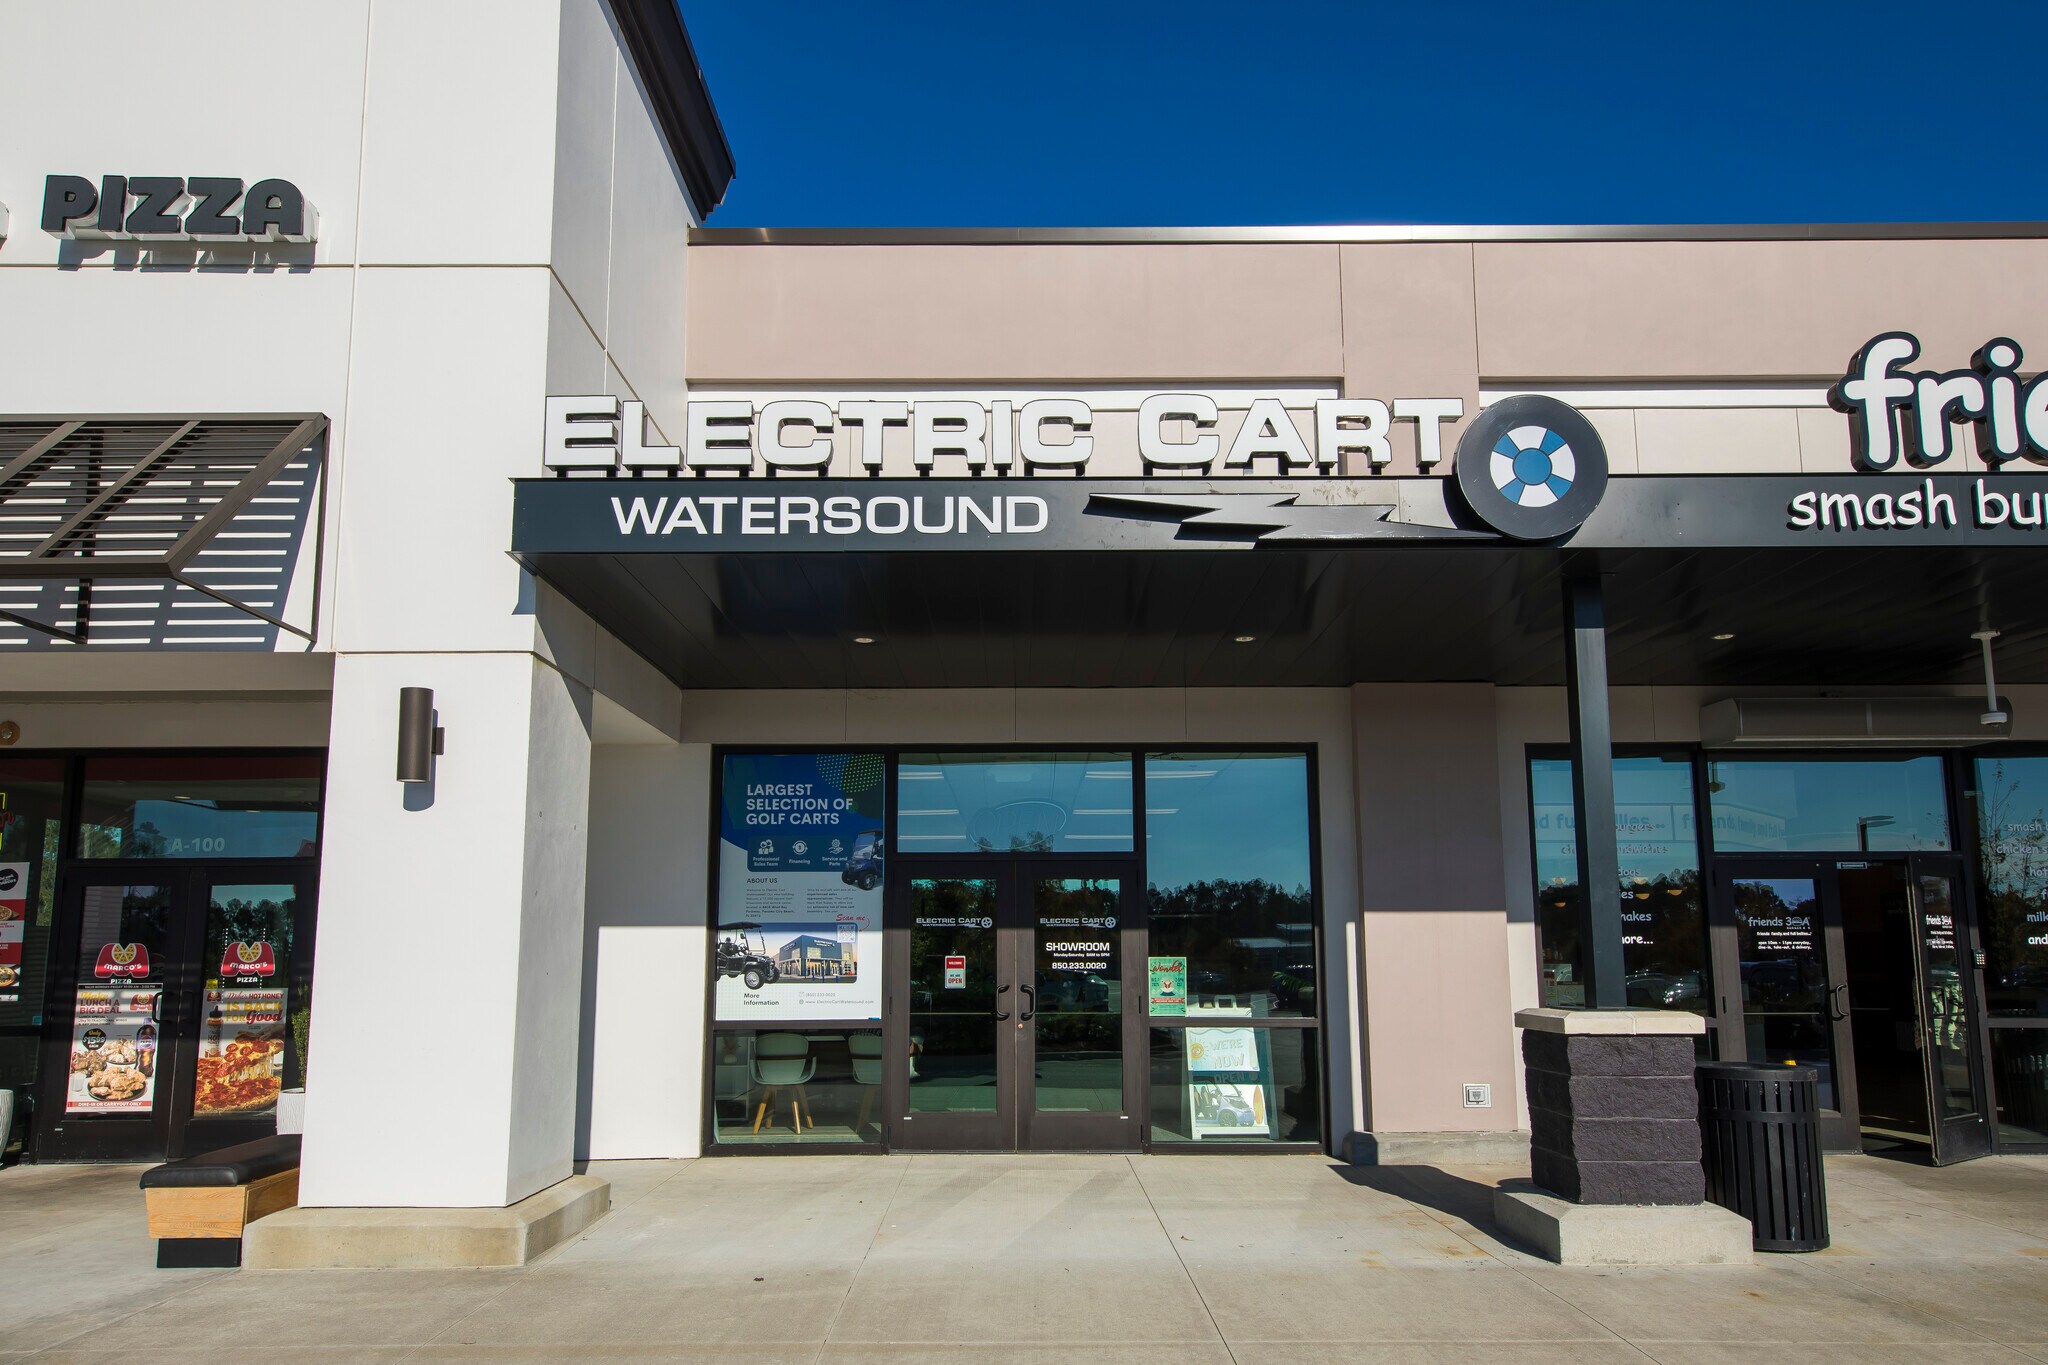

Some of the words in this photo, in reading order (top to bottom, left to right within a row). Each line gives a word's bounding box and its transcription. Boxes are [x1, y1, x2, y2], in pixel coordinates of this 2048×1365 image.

[41, 174, 306, 237] PIZZA
[545, 394, 1094, 471] ELECTRIC
[1138, 394, 1464, 470] CART
[1790, 478, 1957, 527] smash
[1976, 478, 2048, 525] bu
[611, 496, 1048, 535] WATERSOUND
[747, 784, 813, 796] LARGEST
[746, 798, 828, 810] SELECTION
[833, 798, 853, 810] OF
[746, 813, 786, 825] GOLF
[790, 813, 840, 825] CARTS
[171, 837, 226, 853] A-100
[1996, 844, 2039, 854] chicken
[1748, 916, 1783, 926] friends
[1045, 942, 1110, 951] SHOWROOM
[103, 963, 142, 971] MARCO'S
[229, 962, 268, 970] MARCO'S
[226, 1002, 240, 1011] IS
[243, 1002, 282, 1011] BACK
[225, 1014, 246, 1022] FOR
[246, 1009, 284, 1024] Good
[1213, 1054, 1245, 1070] NOW
